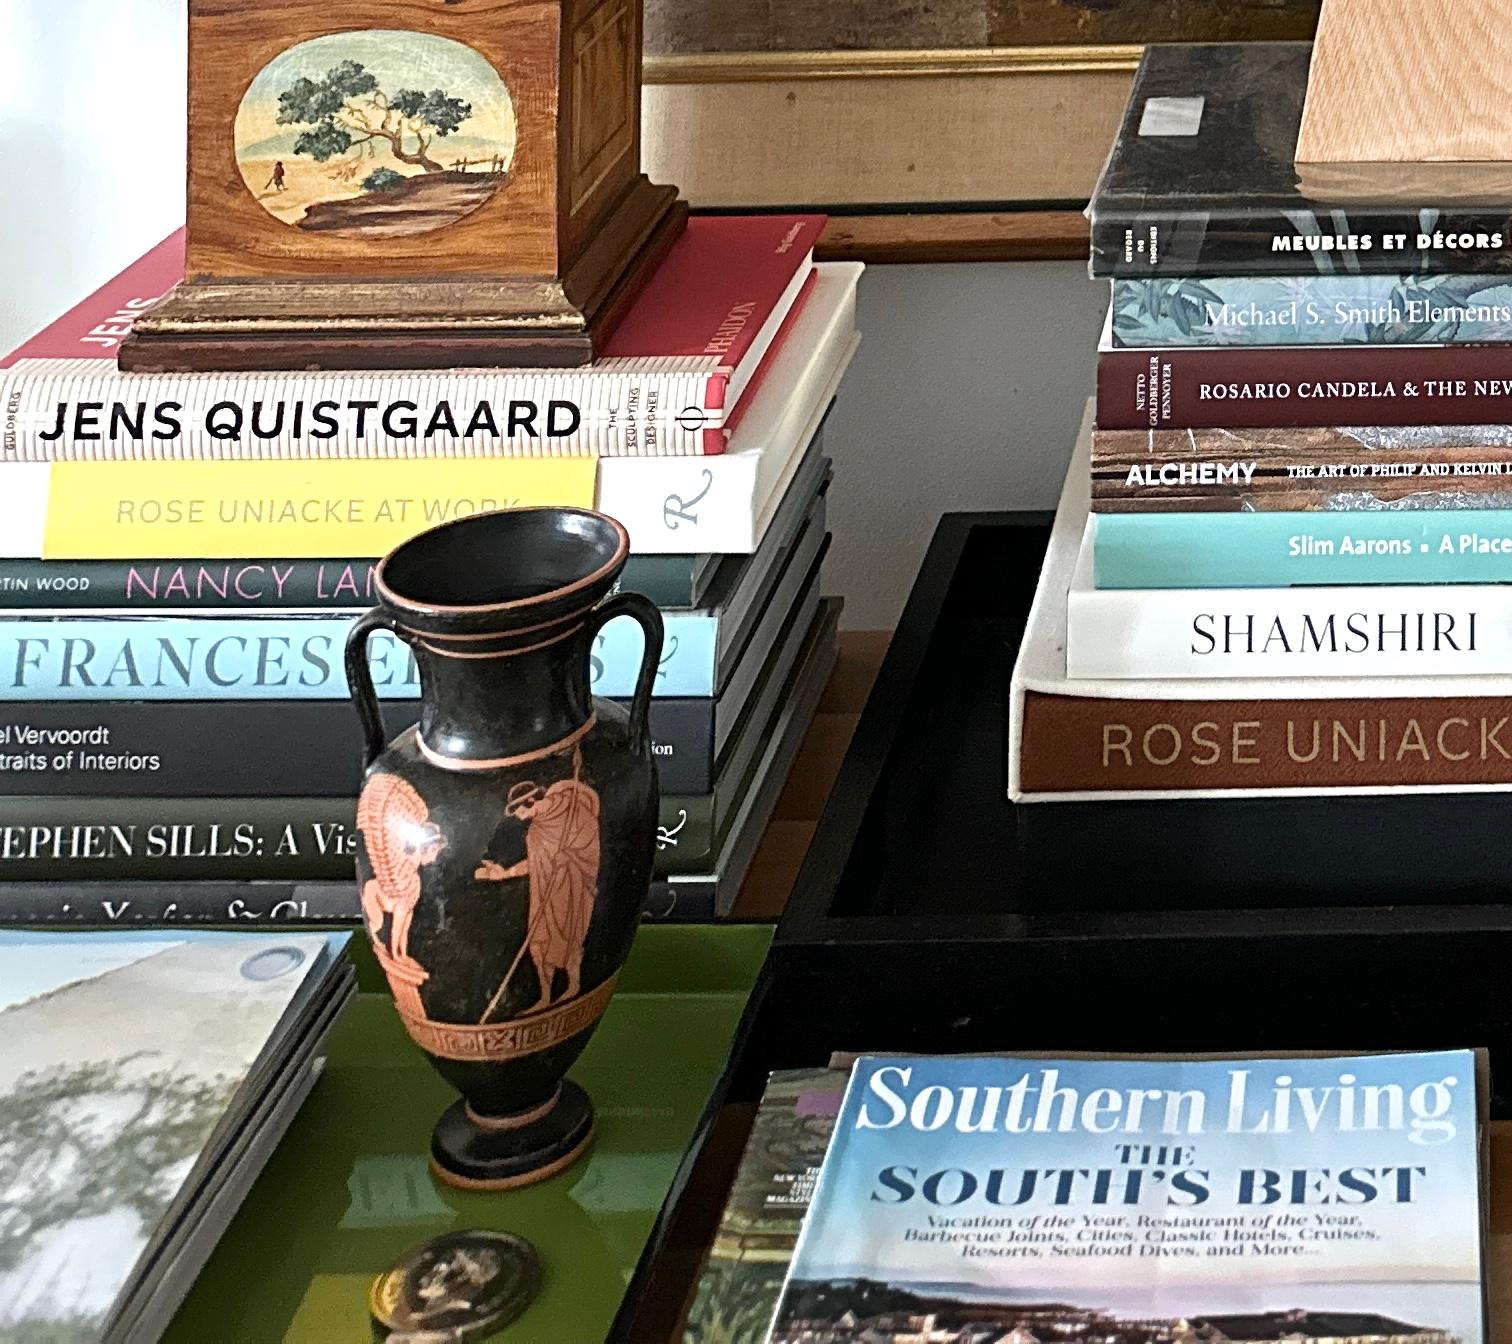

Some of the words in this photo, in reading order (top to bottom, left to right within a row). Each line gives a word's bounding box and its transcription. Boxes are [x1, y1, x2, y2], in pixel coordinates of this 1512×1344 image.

[1272, 233, 1373, 252] MEUBLES
[1382, 234, 1406, 250] ET
[1417, 230, 1503, 250] DÉCORS
[704, 302, 757, 353] PHAIDON
[1205, 302, 1298, 327] Michael
[1306, 302, 1326, 325] S.
[1335, 300, 1401, 325] Smith
[1408, 299, 1511, 325] Elements
[1136, 373, 1146, 412] NETTO
[1149, 356, 1159, 427] GOLDBERGER
[1162, 363, 1172, 420] PENNOYER
[1200, 382, 1291, 400] ROSARIO
[1298, 382, 1396, 399] CANDELA
[1403, 382, 1419, 398] &
[1424, 380, 1466, 397] THE
[39, 401, 183, 440] JENS
[205, 400, 582, 441] QUISTGAARD
[609, 407, 618, 429] THE
[627, 387, 640, 448] SCULPTING
[646, 390, 659, 445] DESIGNER
[1125, 462, 1257, 486] ALCHEMY
[1287, 464, 1314, 479] THE
[1317, 464, 1346, 478] ART
[1349, 463, 1369, 478] OF
[1371, 463, 1417, 477] PHILIP
[1419, 462, 1450, 477] AND
[1454, 462, 1502, 476] KELVIN
[117, 499, 205, 524] ROSE
[219, 499, 365, 524] UNIACKE
[375, 498, 407, 523] AT
[1289, 536, 1335, 557] Slim
[1339, 535, 1412, 556] Aarons
[1438, 535, 1455, 554] A
[1458, 533, 1512, 554] Place
[37, 577, 90, 592] WOOD
[126, 565, 294, 600] NANCY
[1190, 611, 1479, 655] SHAMSHIRI
[11, 635, 333, 688] FRANCES
[14, 725, 109, 745] Vervoordt
[1101, 720, 1261, 768] ROSE
[52, 751, 73, 771] of
[80, 751, 160, 771] Interiors
[0, 825, 137, 859] EPHEN
[146, 824, 264, 858] SILLS:
[274, 823, 301, 857] A
[856, 1065, 1206, 1135] Southern
[1224, 1068, 1458, 1146] Living
[1115, 1144, 1196, 1166] THE
[1237, 1166, 1427, 1206] BEST
[904, 1228, 1001, 1243] Barbecue
[1006, 1228, 1070, 1244] Joints,
[1076, 1228, 1138, 1243] Cities,
[1145, 1228, 1217, 1243] Classic
[1223, 1228, 1292, 1243] Hotels,
[1298, 1228, 1381, 1242] Cruises,
[927, 1214, 1013, 1228] Vacation
[1017, 1214, 1040, 1231] of
[1042, 1214, 1076, 1228] the
[1082, 1214, 1130, 1229] Year,
[1137, 1214, 1246, 1228] Restaurant
[1251, 1214, 1274, 1230] of
[1276, 1214, 1308, 1227] the
[1314, 1213, 1363, 1228] Year,
[961, 1243, 1044, 1259] Resorts,
[1051, 1243, 1133, 1258] Seafood
[1138, 1243, 1200, 1258] Dives,
[1205, 1243, 1244, 1257] and
